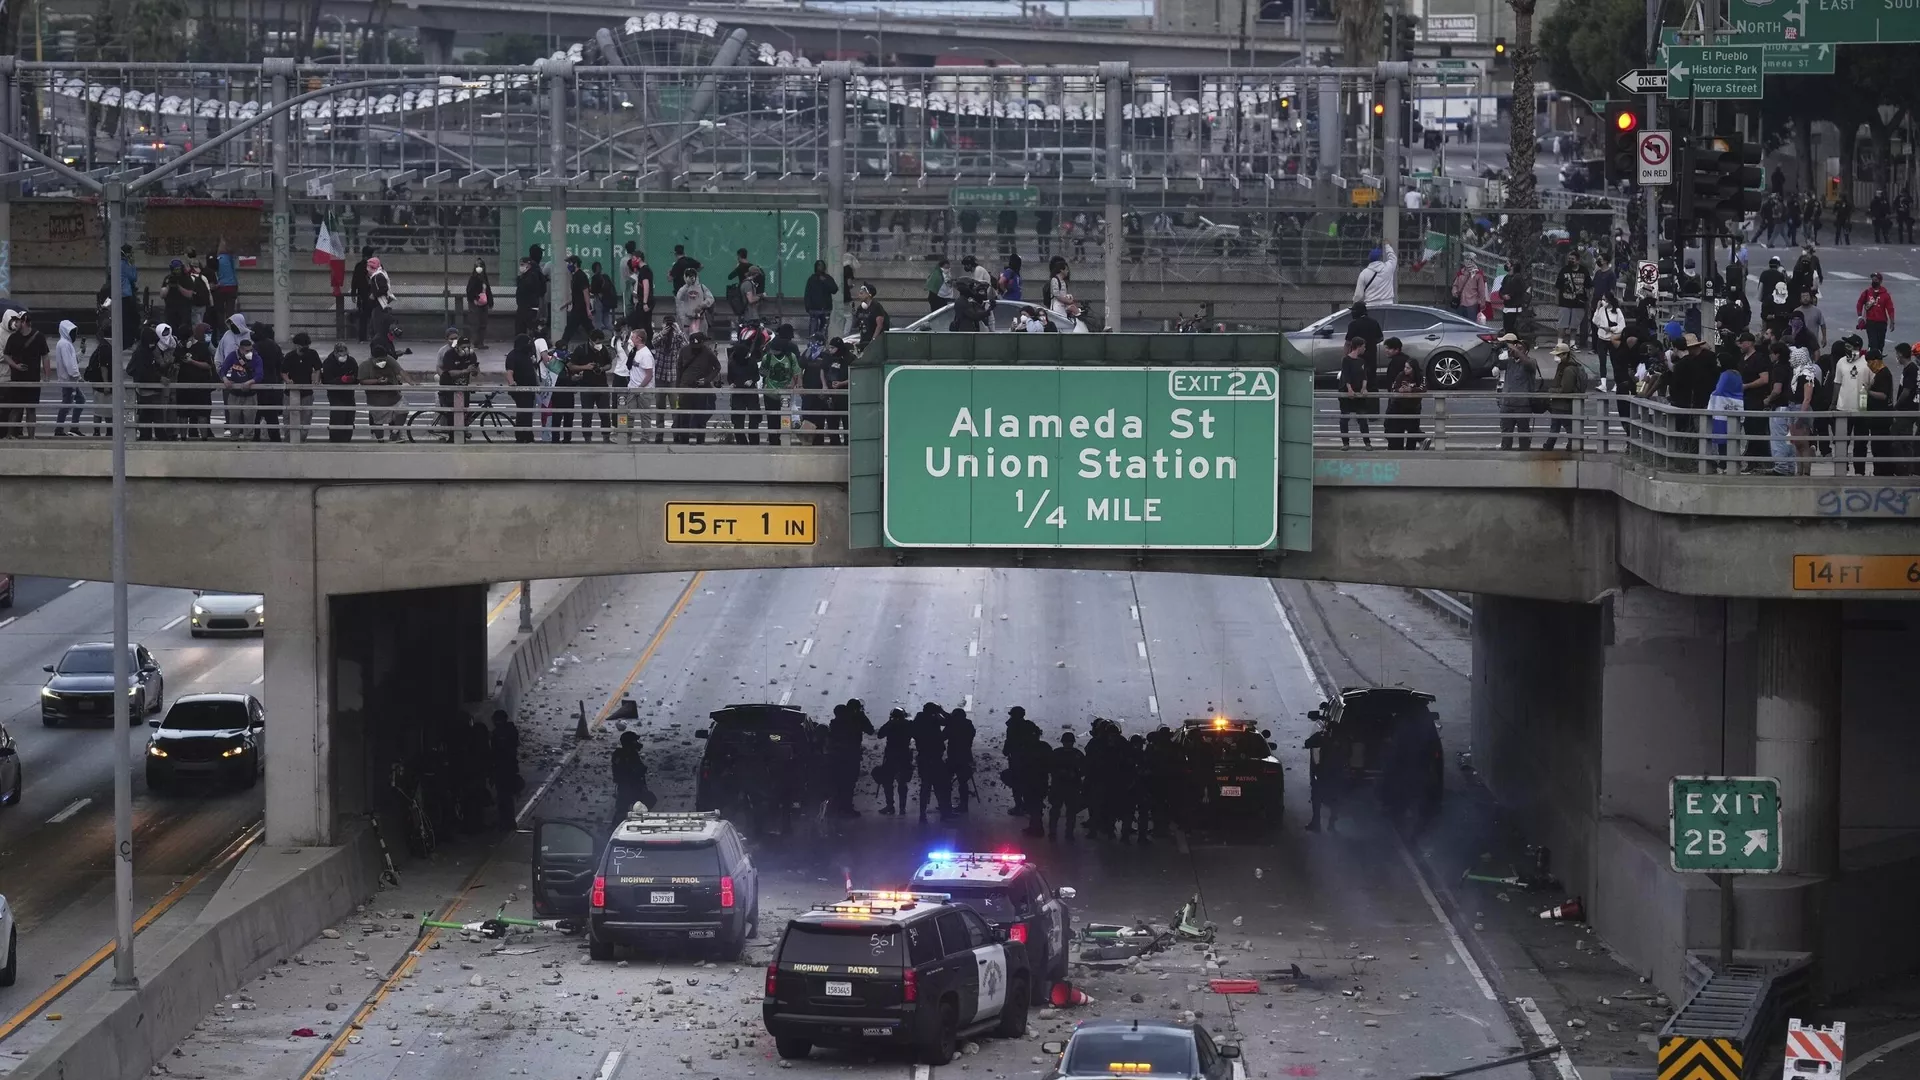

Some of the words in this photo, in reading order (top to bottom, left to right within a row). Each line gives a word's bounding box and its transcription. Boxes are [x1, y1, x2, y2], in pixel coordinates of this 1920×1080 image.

[1737, 20, 1781, 34] NORTH
[1702, 52, 1712, 61] El
[1715, 51, 1749, 61] Pueblo
[1692, 65, 1731, 74] Historic
[1734, 65, 1758, 74] Park
[1638, 76, 1656, 86] ONE
[1725, 84, 1758, 93] Street
[533, 220, 612, 234] Almeda
[613, 244, 628, 258] R
[780, 242, 806, 261] 3/4
[1174, 376, 1221, 392] EXIT
[1228, 372, 1272, 396] 2A
[949, 407, 1142, 439] Alameda
[1170, 408, 1215, 439] St
[926, 446, 1048, 478] Union
[1078, 448, 1236, 479] Station
[1015, 489, 1067, 528] 1/4
[1087, 498, 1162, 522] MILE
[677, 512, 706, 534] 15
[713, 520, 737, 535] FT
[762, 512, 769, 535] 1
[785, 520, 804, 536] IN
[1809, 562, 1833, 583] 14
[1840, 566, 1863, 584] FT
[1686, 794, 1764, 814] EXIT
[1684, 828, 1727, 855] 2B
[613, 846, 645, 859] 552
[870, 933, 895, 947] 561
[793, 963, 830, 972] HIGHWAY
[848, 966, 879, 974] PATROL
